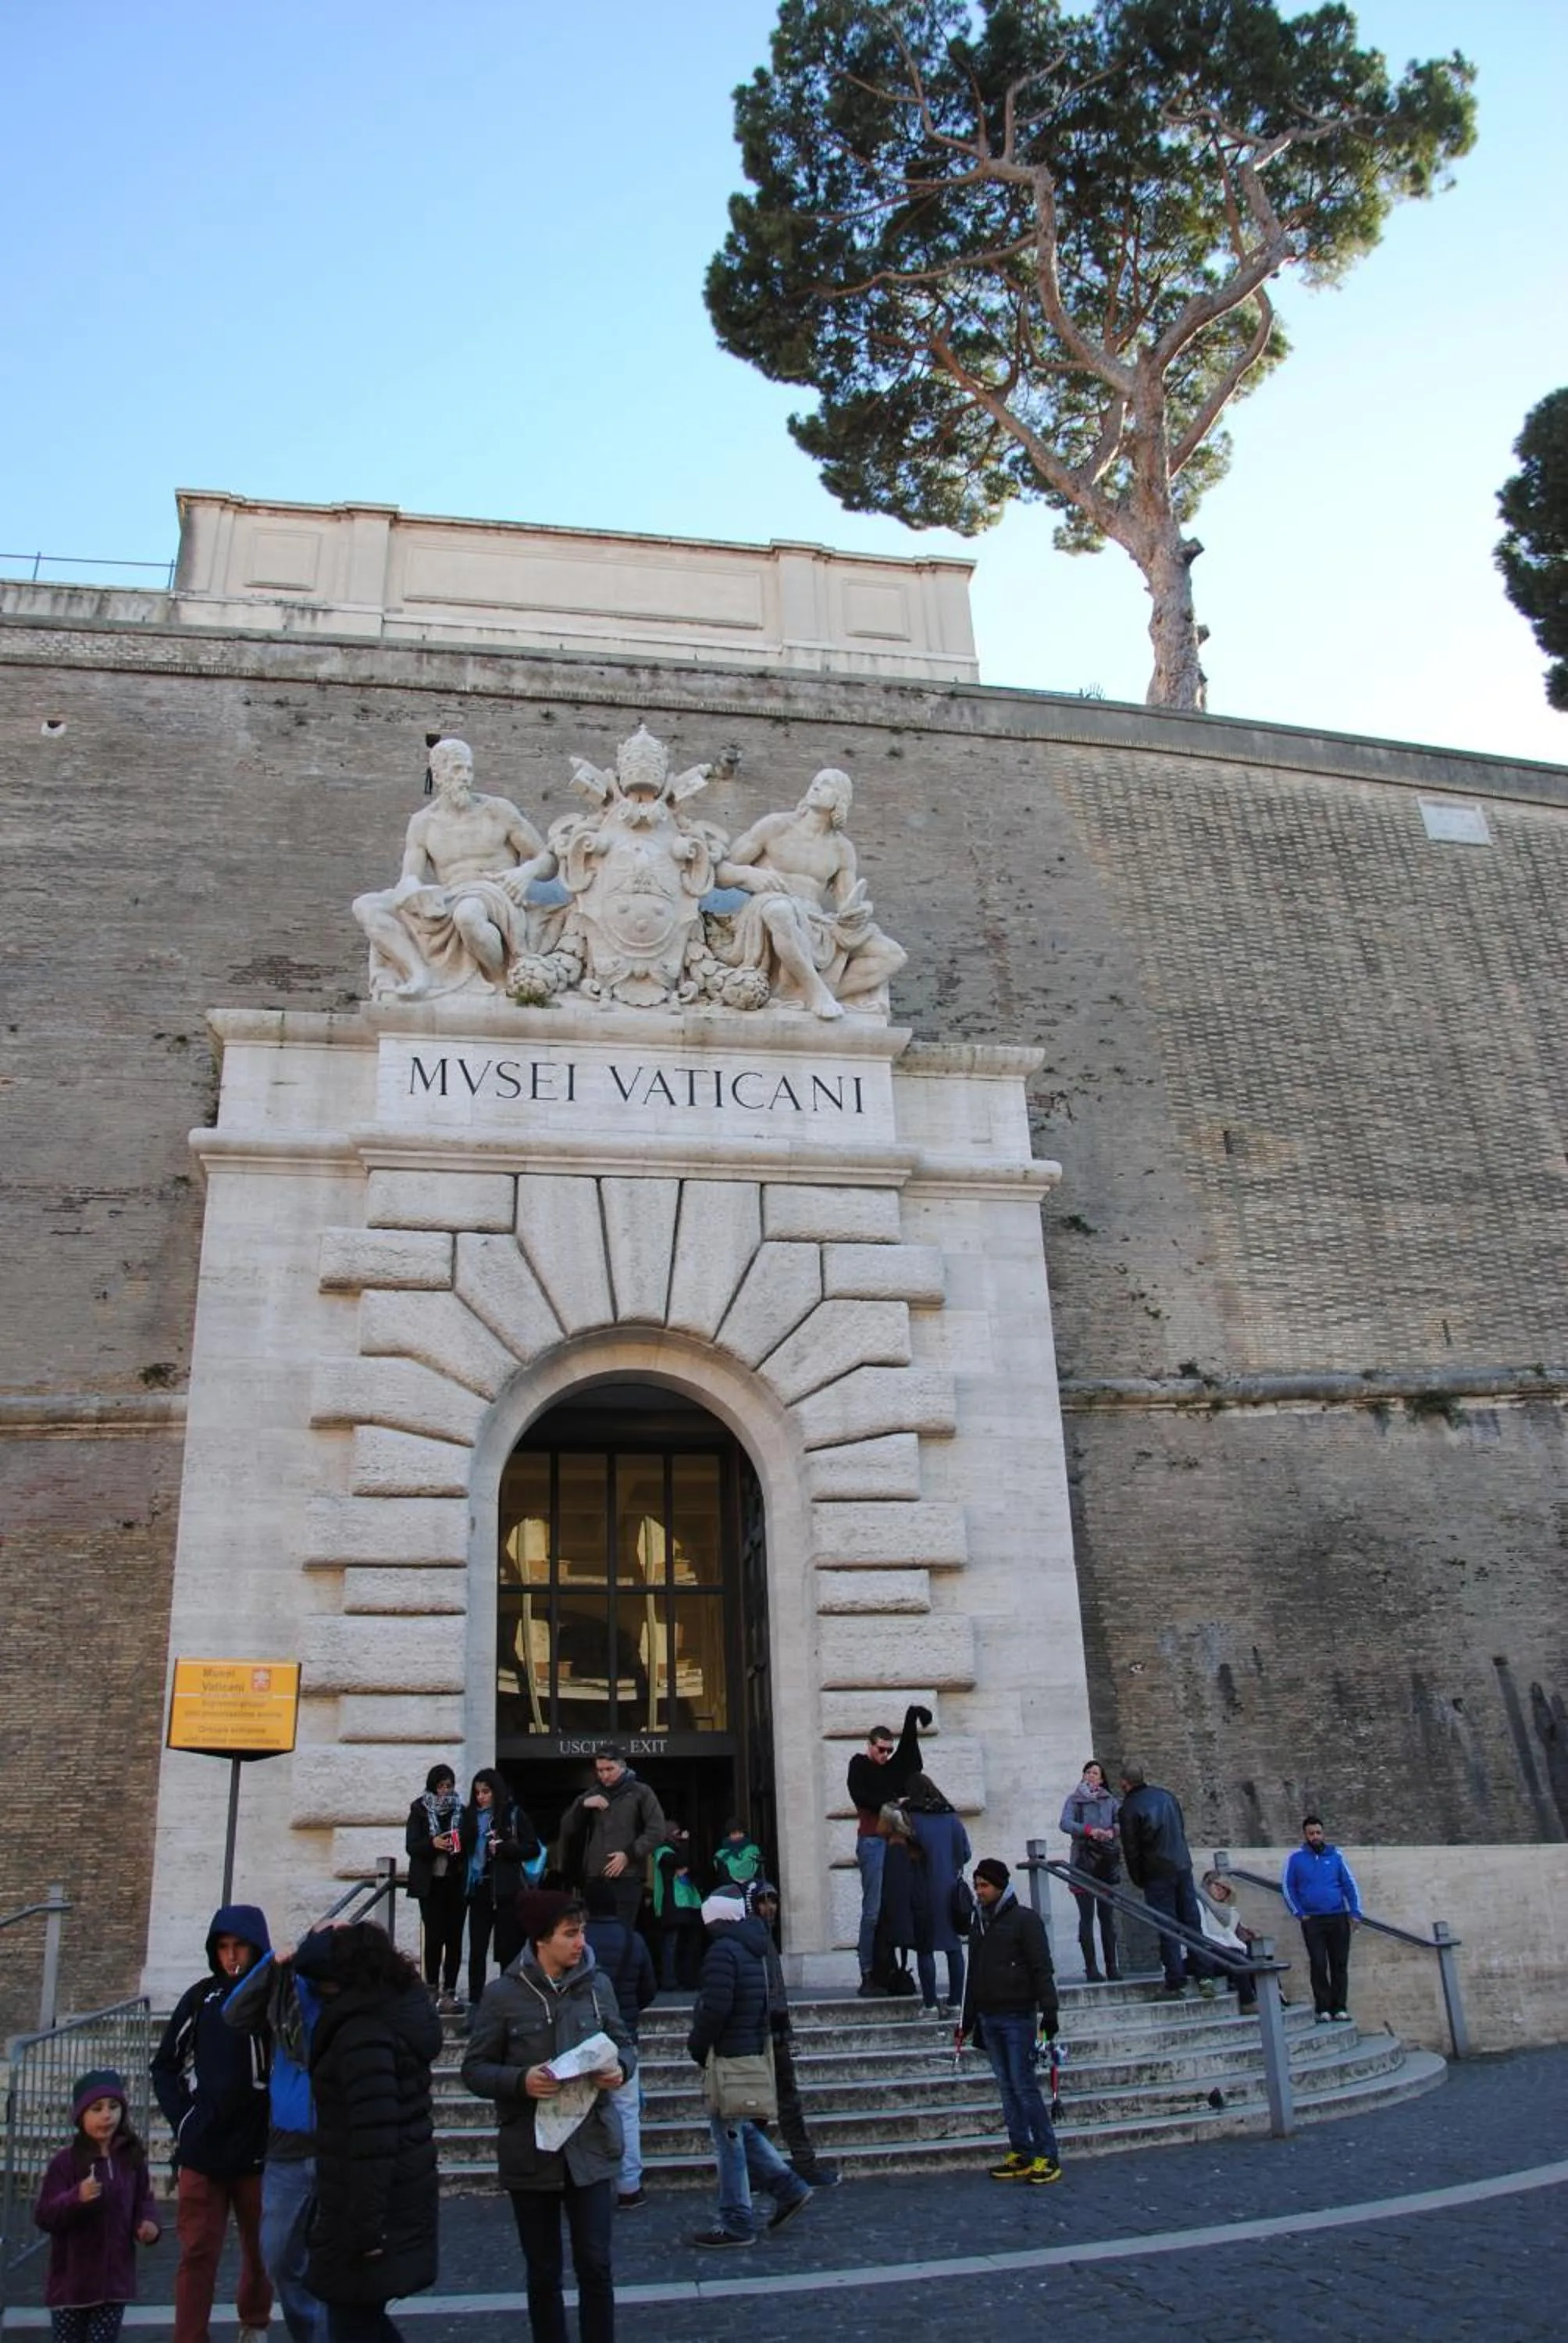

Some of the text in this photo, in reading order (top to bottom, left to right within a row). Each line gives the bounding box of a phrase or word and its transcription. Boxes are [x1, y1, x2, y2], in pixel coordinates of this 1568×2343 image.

[408, 1056, 863, 1113] MVSEI VATICANI
[560, 1739, 613, 1754] USCIT
[630, 1739, 668, 1753] EXIT
